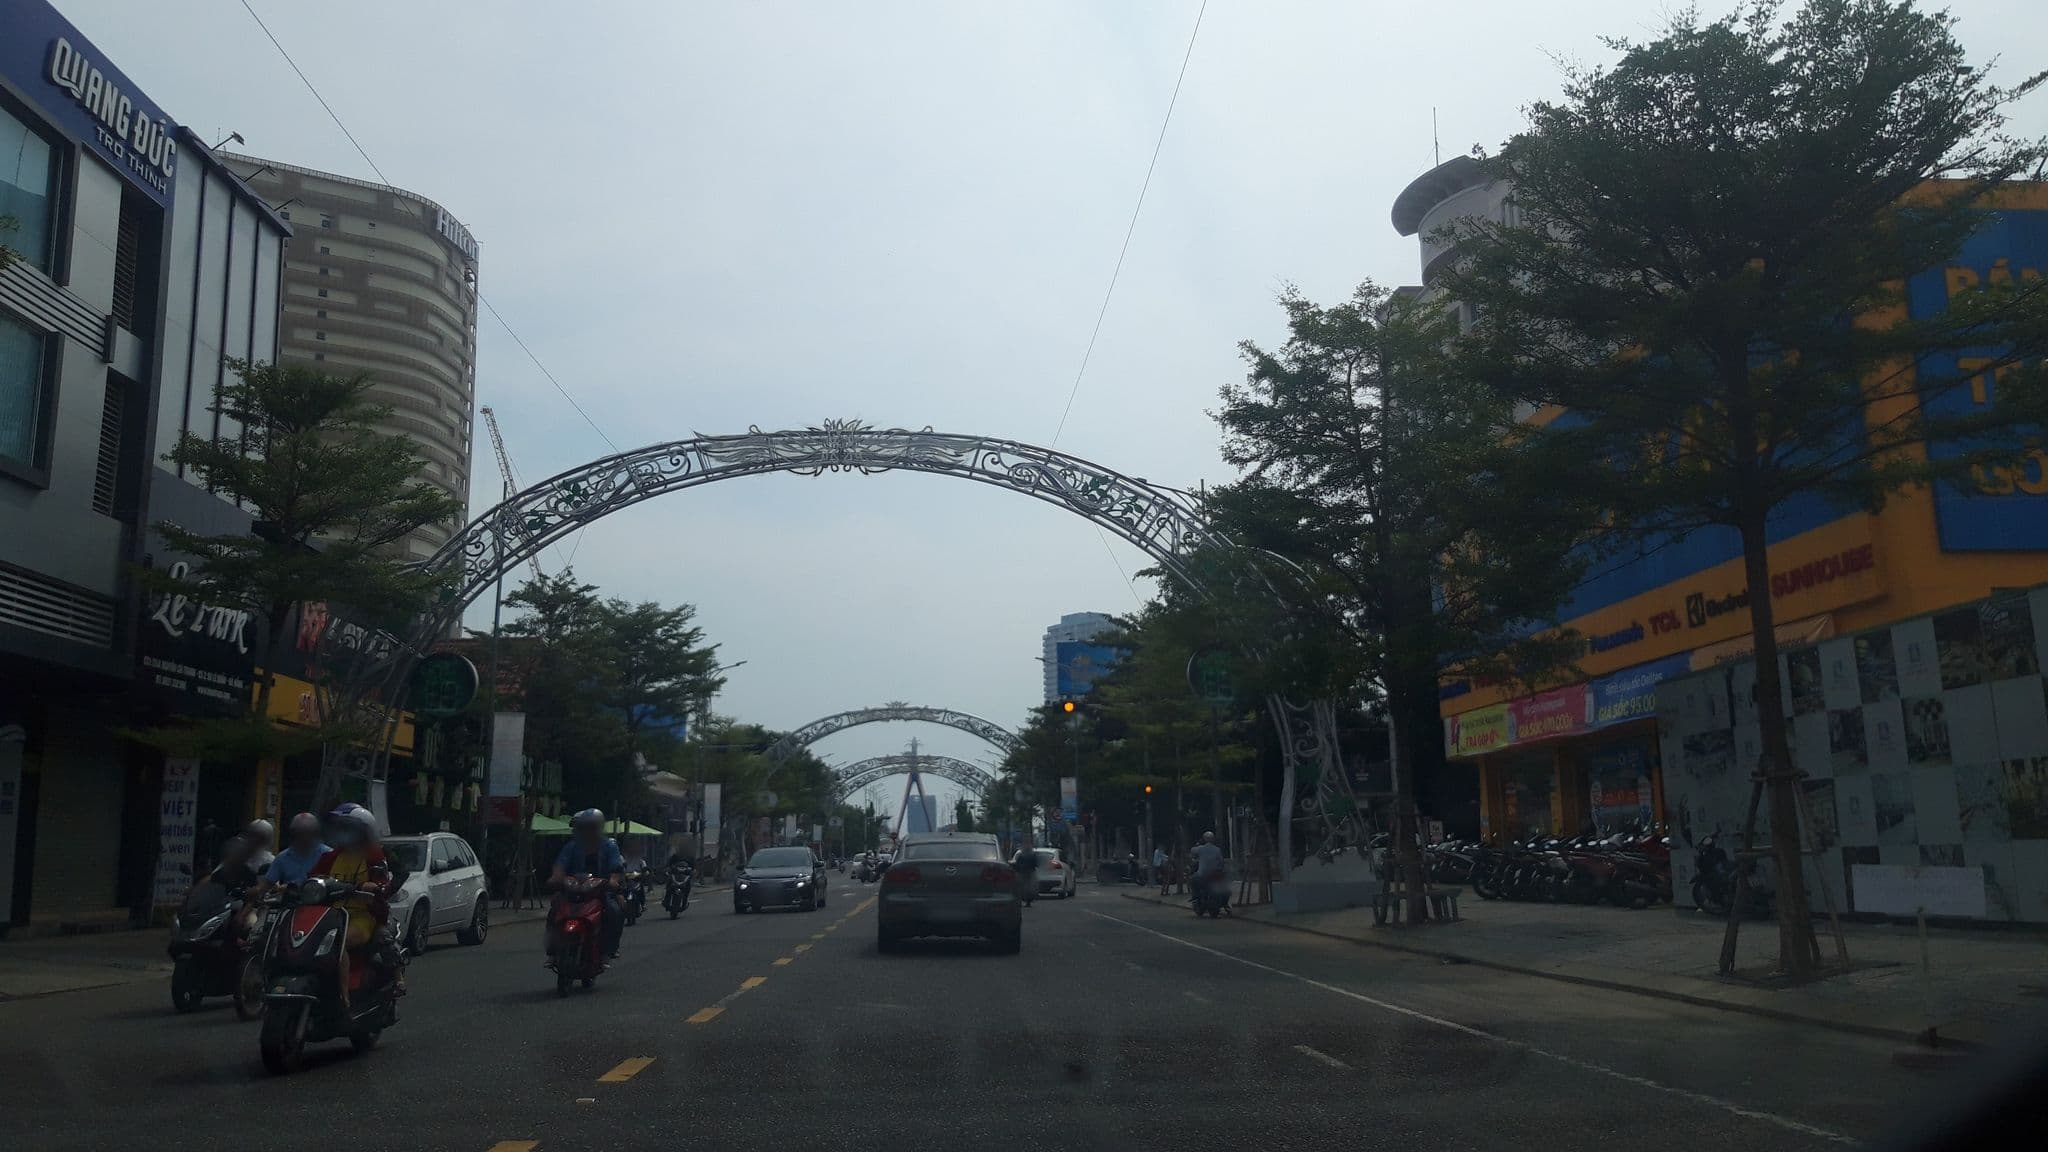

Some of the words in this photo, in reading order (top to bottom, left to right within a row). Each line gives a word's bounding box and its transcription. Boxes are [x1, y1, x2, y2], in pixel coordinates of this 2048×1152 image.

[52, 37, 132, 140] QUANG
[134, 109, 177, 178] ĐỨC
[1649, 609, 1681, 635] TCL
